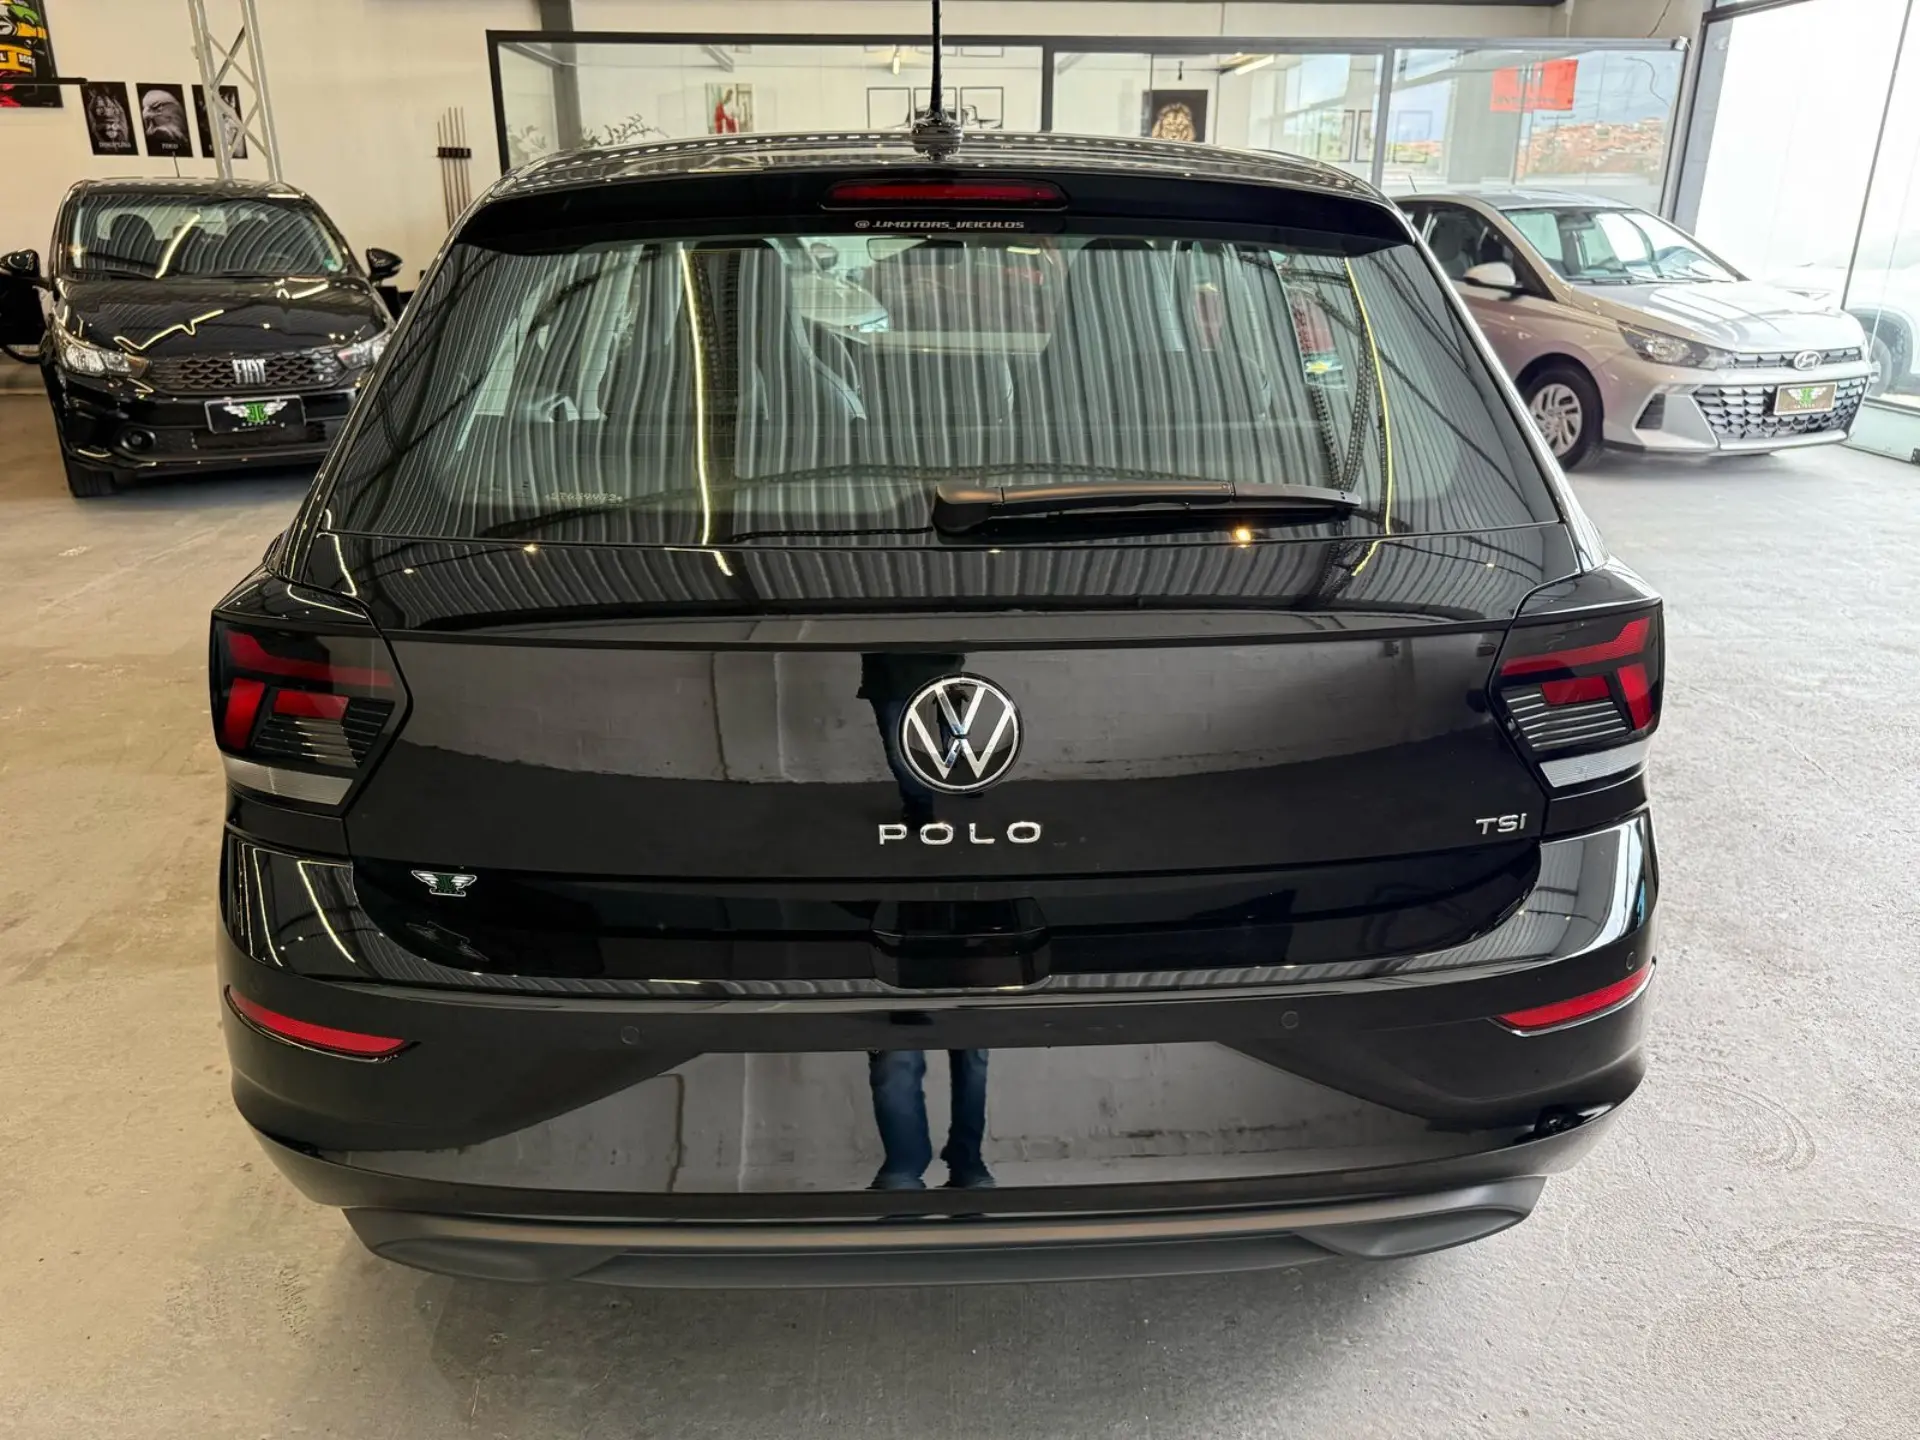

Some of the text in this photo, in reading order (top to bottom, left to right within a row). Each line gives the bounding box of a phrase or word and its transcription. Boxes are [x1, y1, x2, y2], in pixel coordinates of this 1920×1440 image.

[232, 359, 266, 384] FIAT
[878, 821, 1041, 846] POLO
[1475, 813, 1527, 835] TSI
